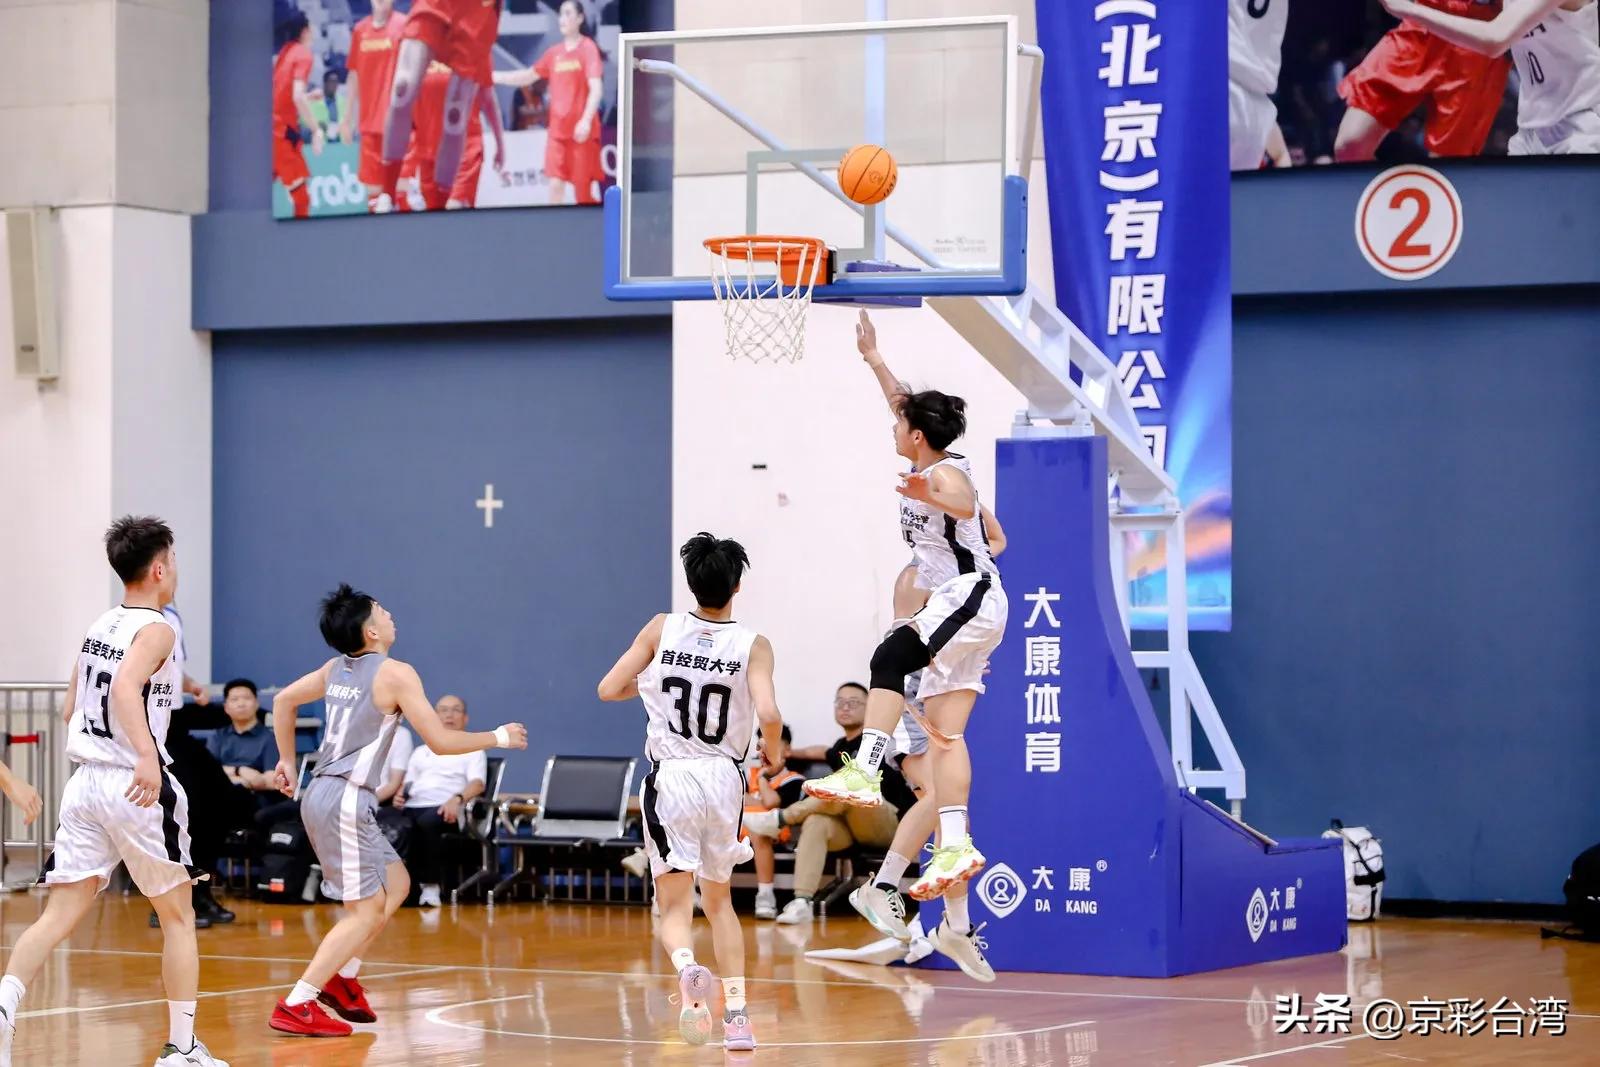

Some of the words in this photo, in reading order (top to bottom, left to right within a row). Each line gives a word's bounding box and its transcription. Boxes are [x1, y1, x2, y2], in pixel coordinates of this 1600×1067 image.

[1388, 188, 1431, 258] 2
[660, 649, 742, 676] 首经贸大学
[1023, 586, 1062, 773] 大康体育
[80, 664, 114, 740] 13
[661, 676, 732, 745] 30
[1032, 865, 1091, 892] 大康
[1035, 898, 1051, 913] DA
[1065, 899, 1098, 915] KANG
